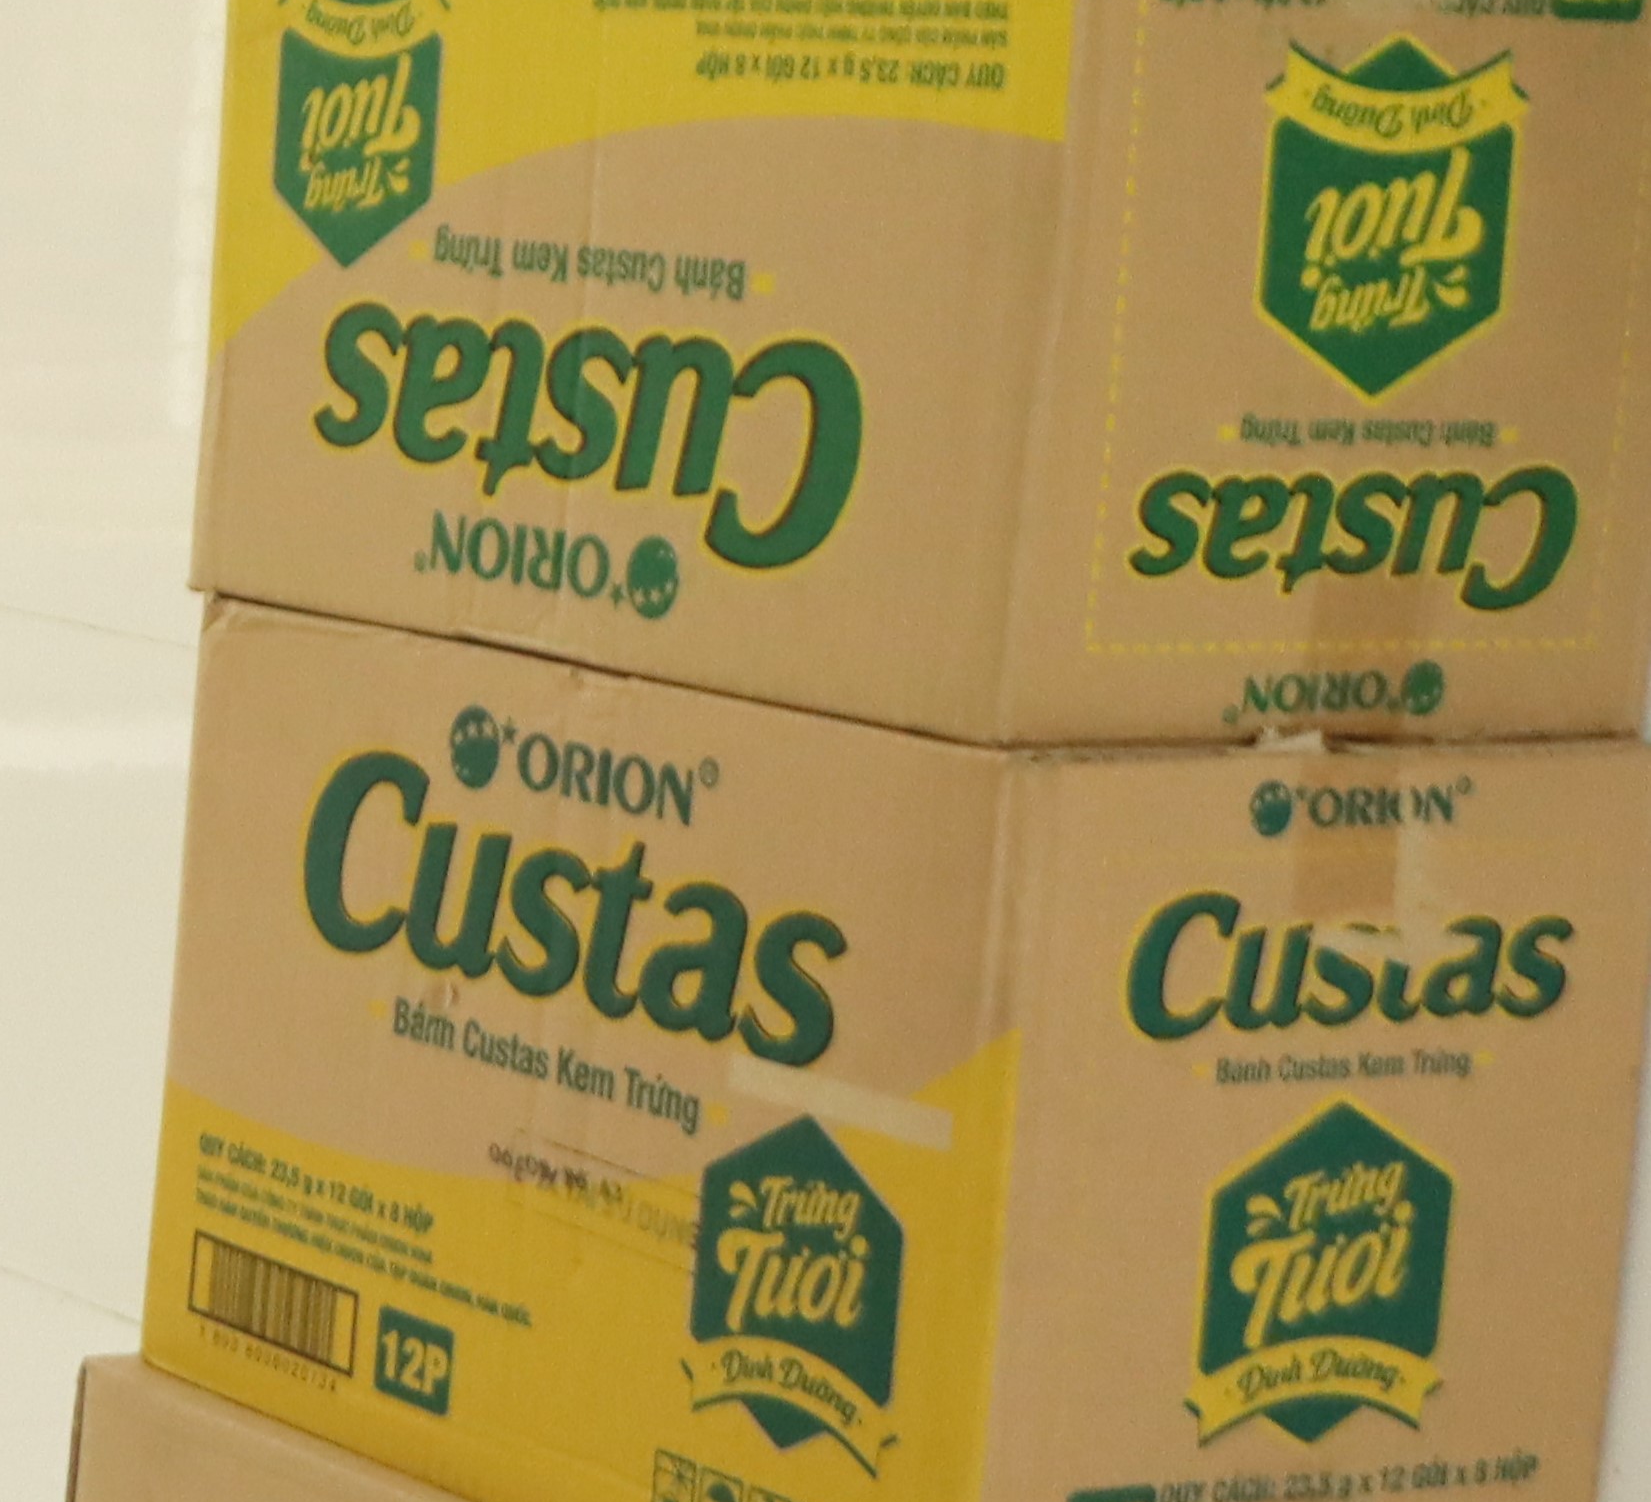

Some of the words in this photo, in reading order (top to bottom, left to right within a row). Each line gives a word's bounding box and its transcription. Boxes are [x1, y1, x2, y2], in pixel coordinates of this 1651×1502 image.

[800, 55, 821, 81] 12
[965, 61, 1005, 91] QUY
[1303, 148, 1484, 288] Tươi
[433, 224, 504, 280] Trứng
[511, 240, 569, 284] Kem
[576, 244, 666, 293] Custas
[673, 254, 746, 302] Bánh
[1309, 267, 1430, 333] Trứng
[313, 301, 864, 569] Custas
[1308, 417, 1356, 446] Kem
[429, 510, 611, 600] ORION
[1128, 465, 1579, 611] Custas
[1242, 670, 1389, 714] ORION
[516, 732, 694, 827] ORION
[303, 750, 848, 1068] Custas
[392, 997, 455, 1050] Bánh
[462, 1018, 549, 1081] Custas
[556, 1045, 615, 1100] Kem
[623, 1064, 700, 1136] Trứng
[1278, 1053, 1351, 1083] Custas
[1357, 1051, 1405, 1077] Kem
[329, 1180, 347, 1204] 12
[758, 1175, 861, 1239] Trứng
[1283, 1161, 1408, 1231] Trứng
[716, 1227, 870, 1334] Tươi
[1230, 1201, 1413, 1349] Tươi
[381, 1328, 449, 1396] 12P
[1380, 1464, 1405, 1494] 12
